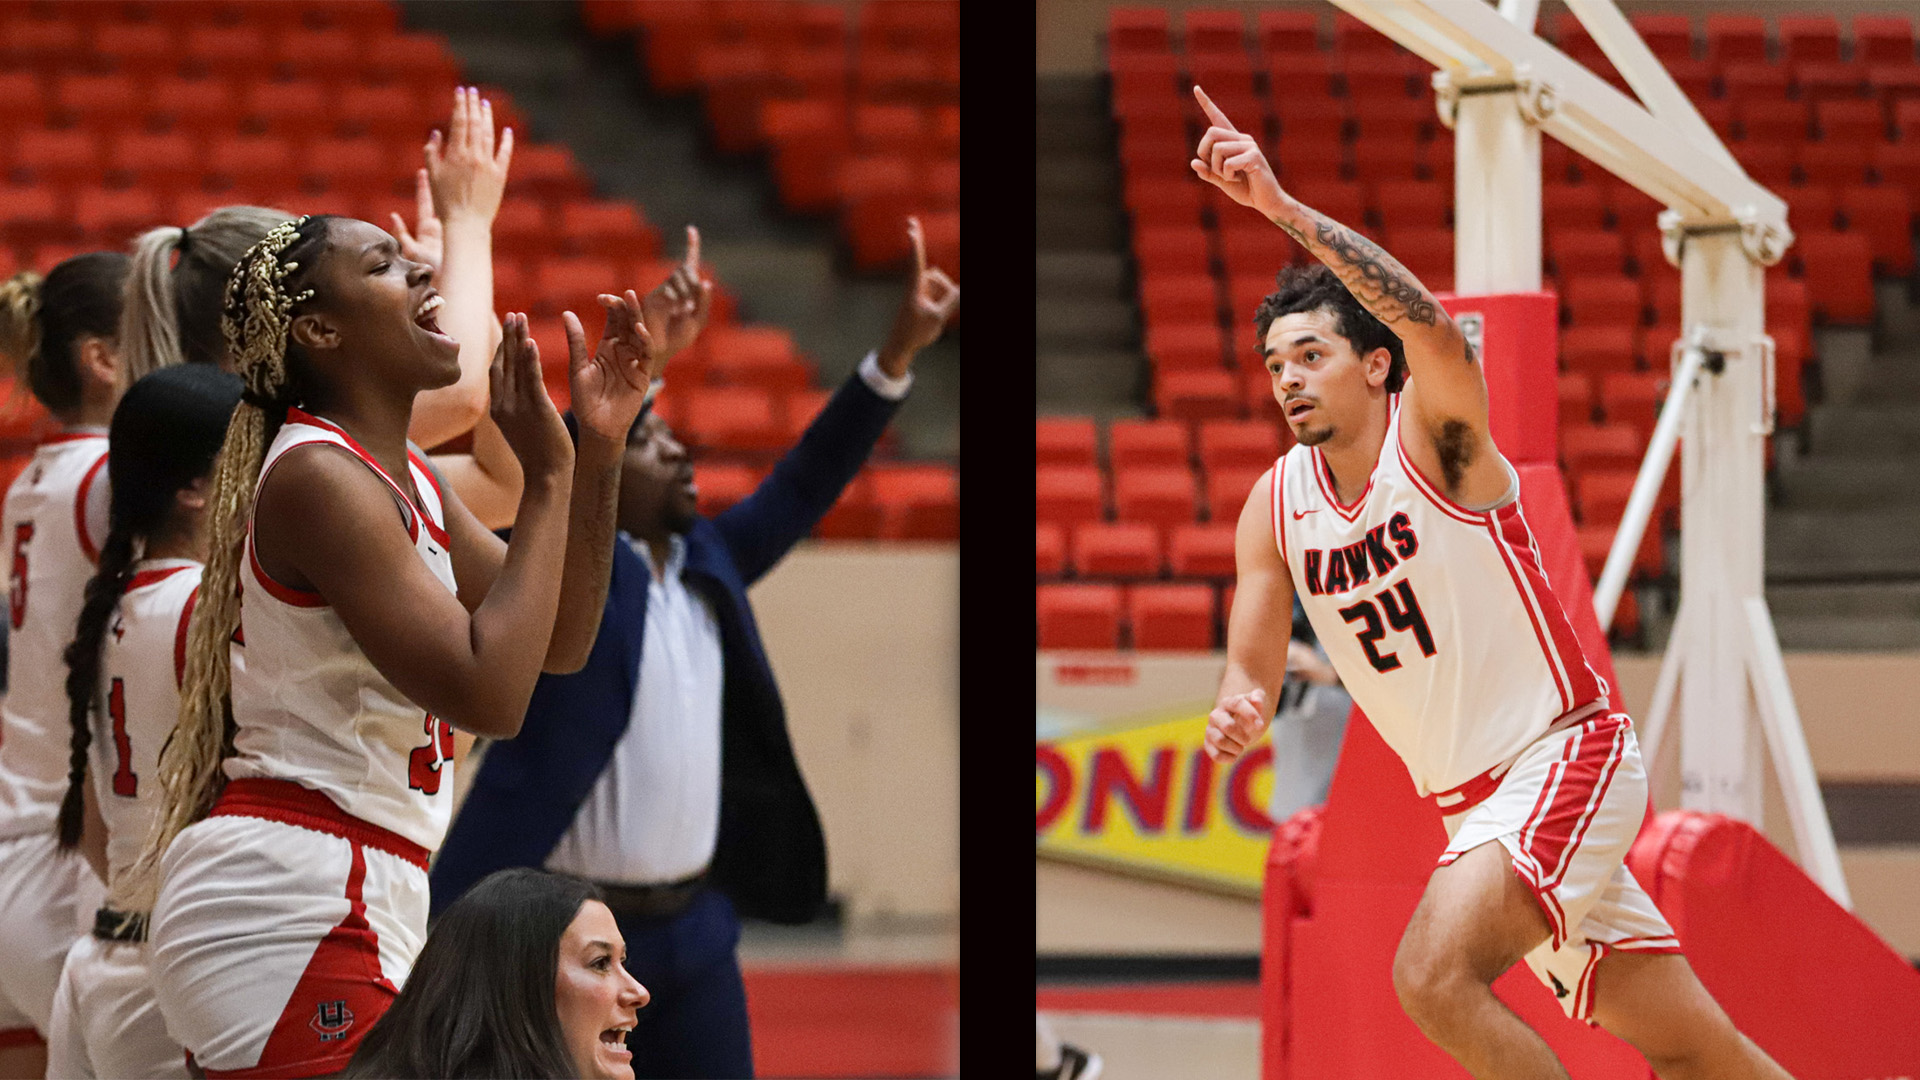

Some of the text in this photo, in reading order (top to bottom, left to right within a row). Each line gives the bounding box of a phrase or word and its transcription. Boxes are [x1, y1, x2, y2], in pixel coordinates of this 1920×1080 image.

[10, 521, 35, 631] 5
[1304, 511, 1419, 596] HAWKS
[1338, 577, 1438, 674] 24
[108, 677, 137, 797] 1
